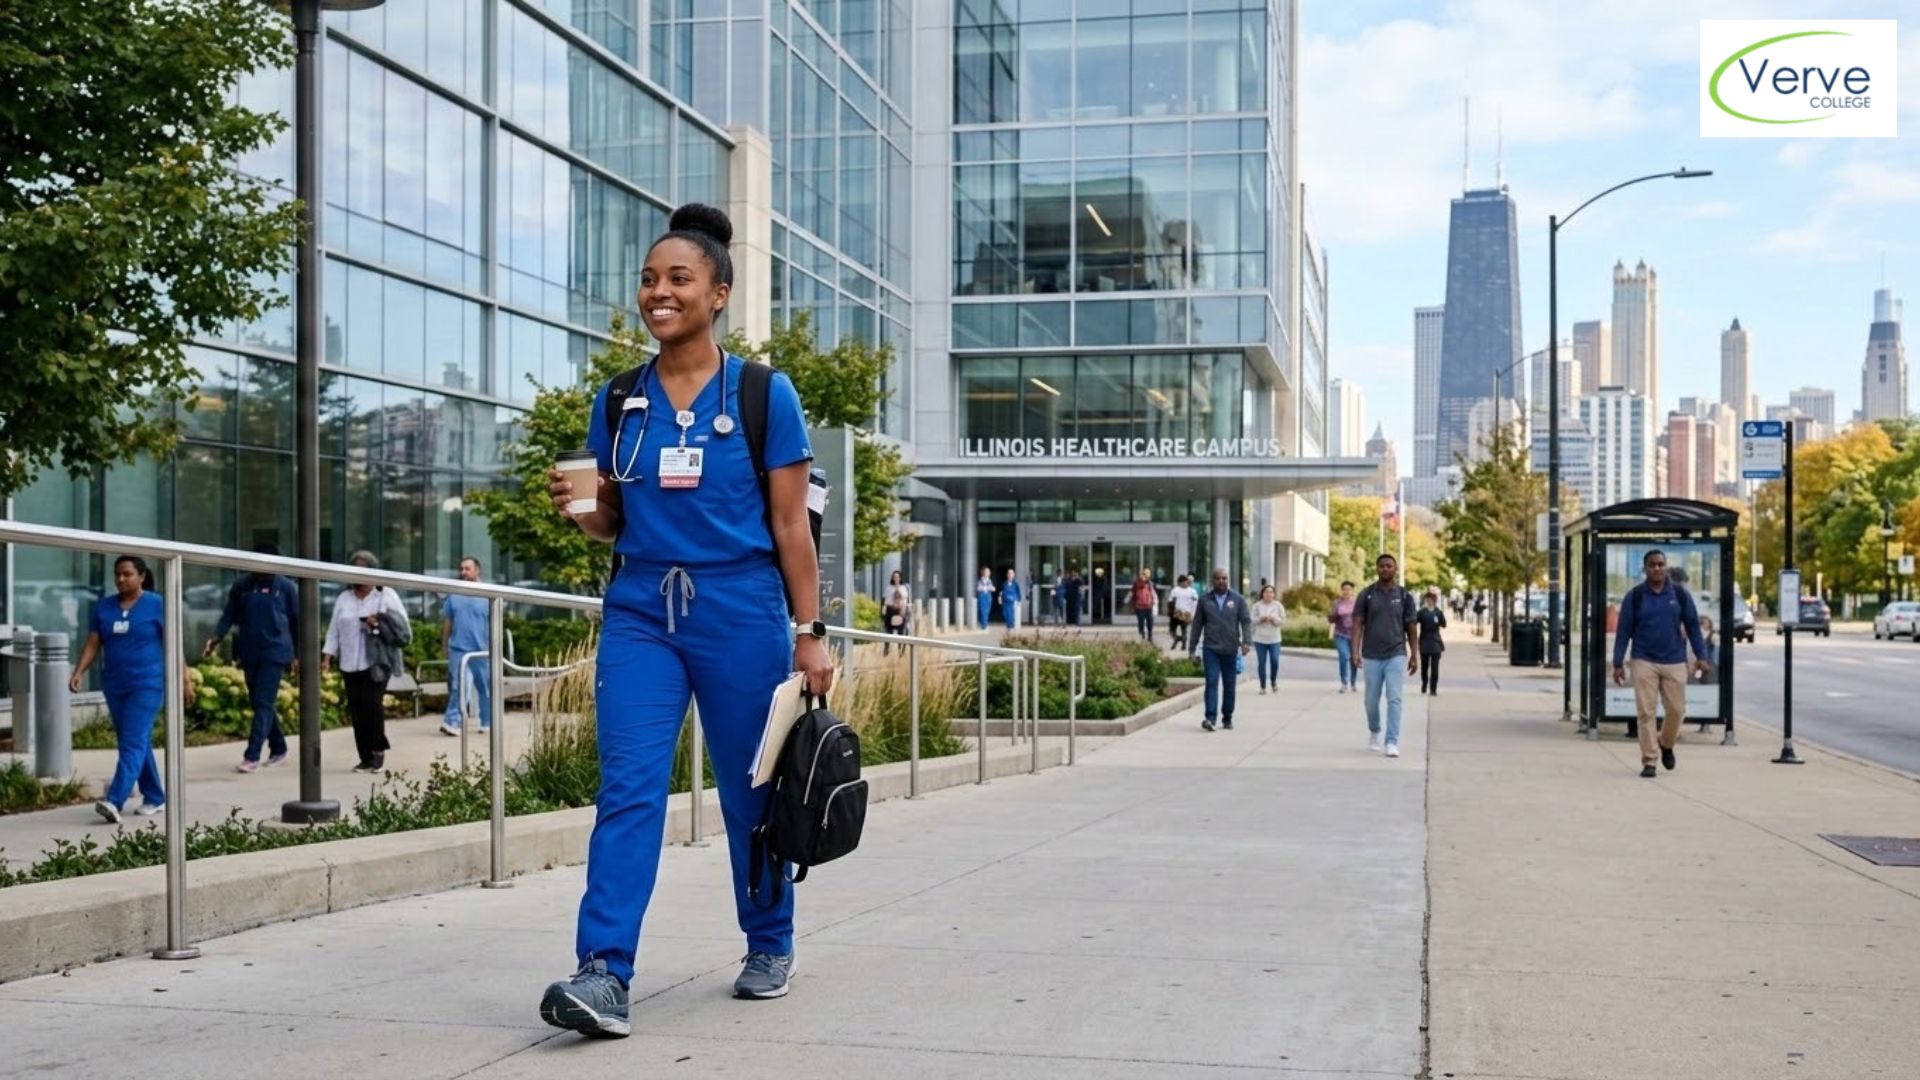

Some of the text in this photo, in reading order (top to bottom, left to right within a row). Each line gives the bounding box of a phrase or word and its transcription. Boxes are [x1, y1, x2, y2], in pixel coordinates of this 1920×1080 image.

[959, 438, 1280, 457] ILLINOIS HEALTHCARE CAMPUS
